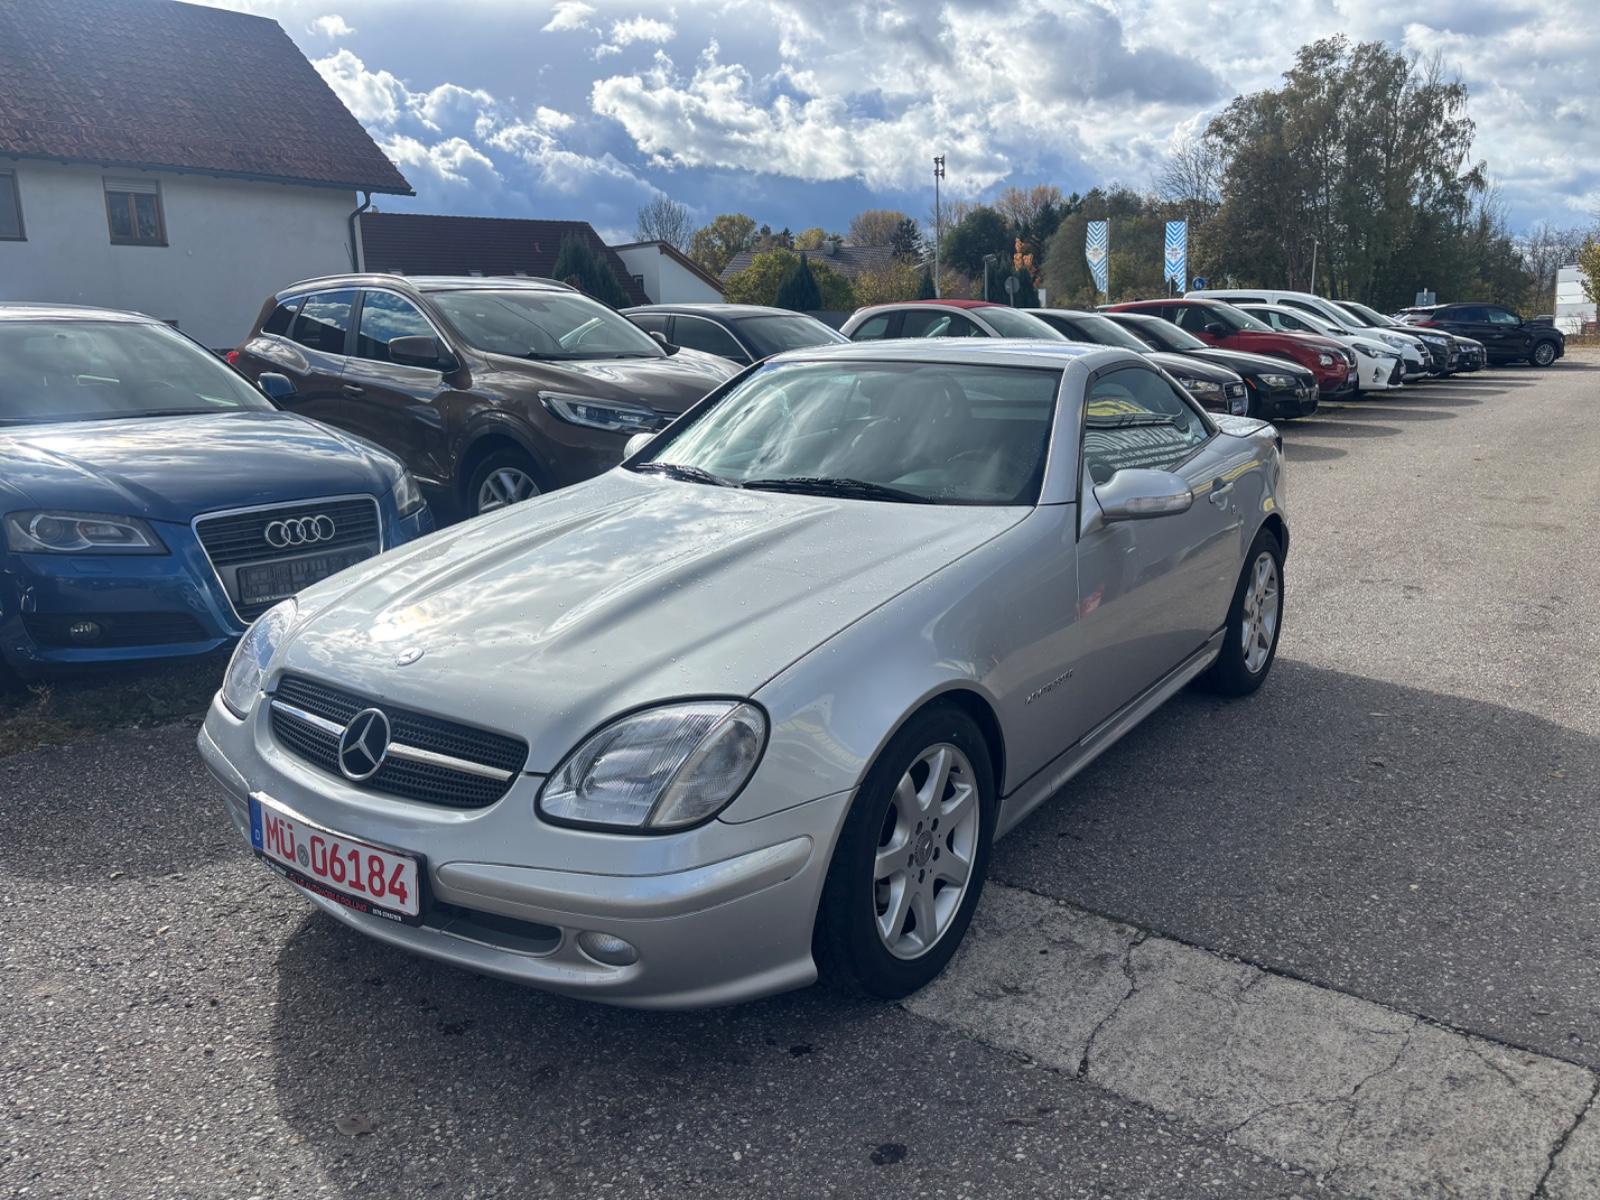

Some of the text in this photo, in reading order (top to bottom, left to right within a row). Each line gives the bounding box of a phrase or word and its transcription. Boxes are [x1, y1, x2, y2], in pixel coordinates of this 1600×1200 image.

[255, 829, 261, 841] D
[265, 811, 408, 905] MÜ 06184
